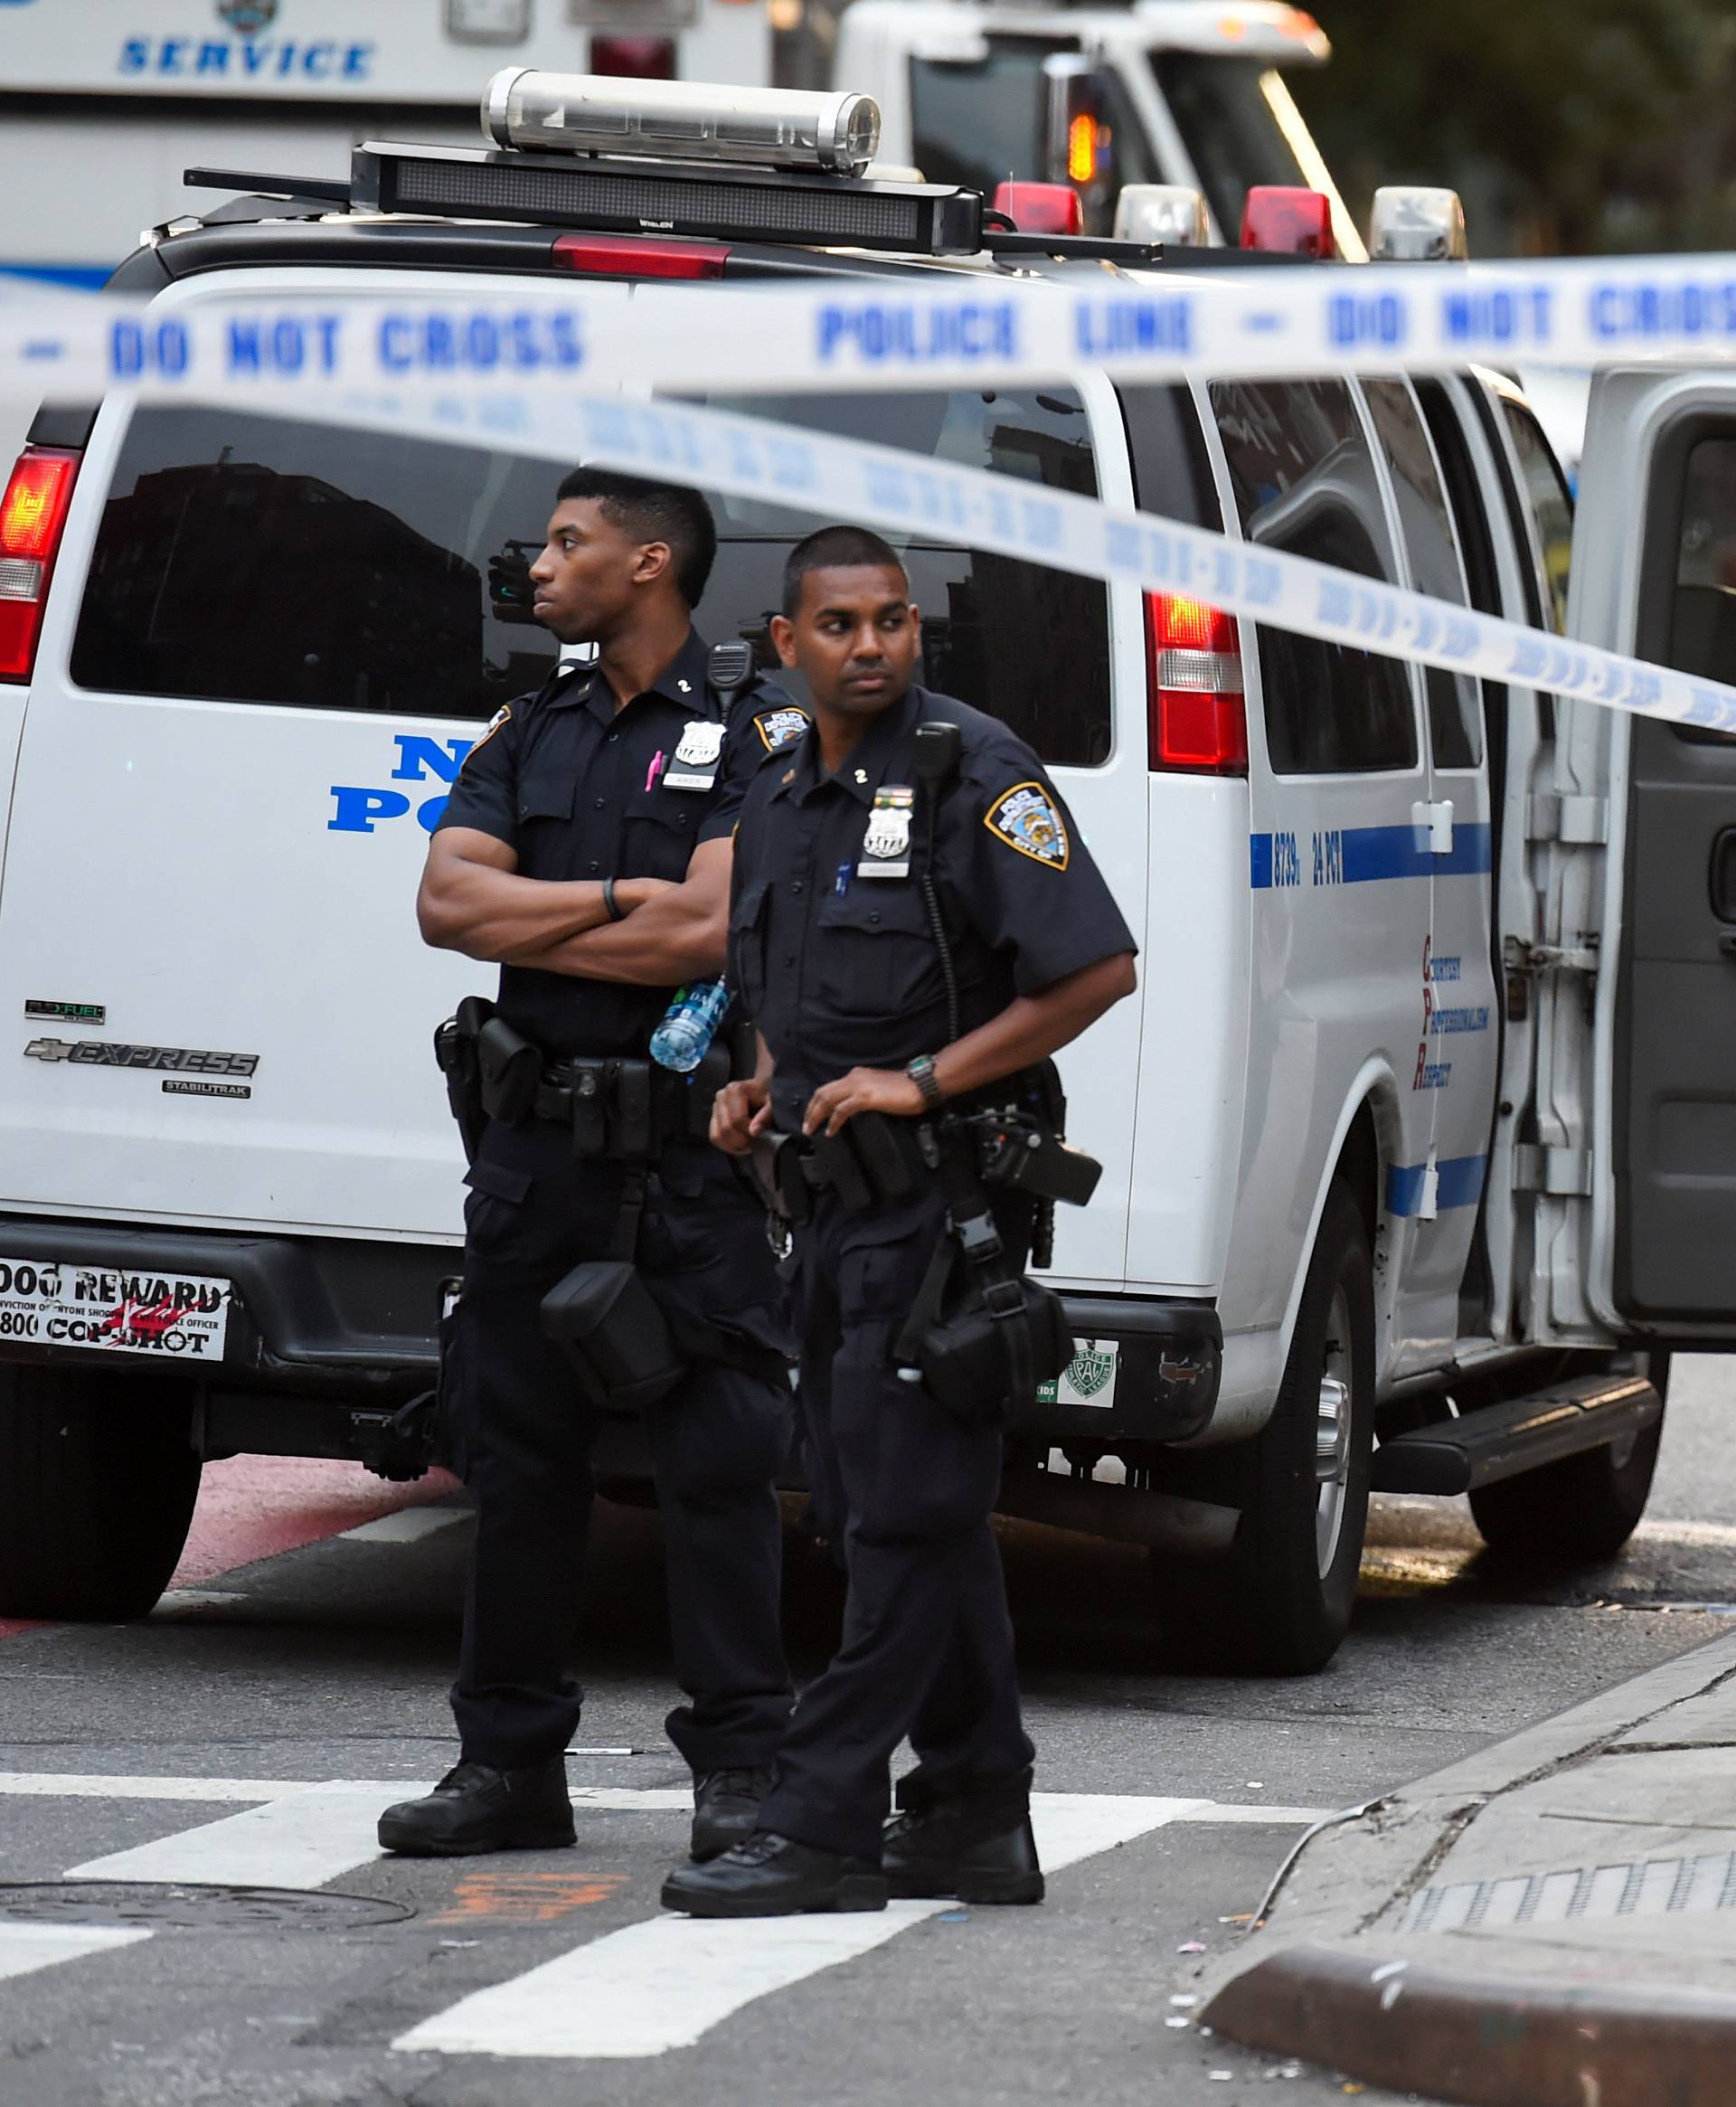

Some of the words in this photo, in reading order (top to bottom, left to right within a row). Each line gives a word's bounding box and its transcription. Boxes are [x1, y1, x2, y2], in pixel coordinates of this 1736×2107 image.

[118, 36, 373, 78] SERVICE
[111, 317, 191, 376] DO
[227, 314, 342, 375] NOT
[378, 308, 584, 373] CROSS
[817, 298, 1016, 360] POLICE
[1075, 294, 1194, 355] LINE
[1328, 291, 1407, 350] DO
[1443, 283, 1552, 343] NOT
[1312, 832, 1324, 885] 24
[1325, 830, 1341, 885] PCT
[73, 1041, 257, 1074] EXPRESS
[165, 1081, 247, 1095] STABILITRAK
[75, 1271, 222, 1313] REWARD
[55, 1305, 86, 1317] NYONE
[186, 1318, 219, 1330] OFFICER
[1076, 1361, 1099, 1382] PAL
[1088, 1366, 1110, 1393] LEAGUE
